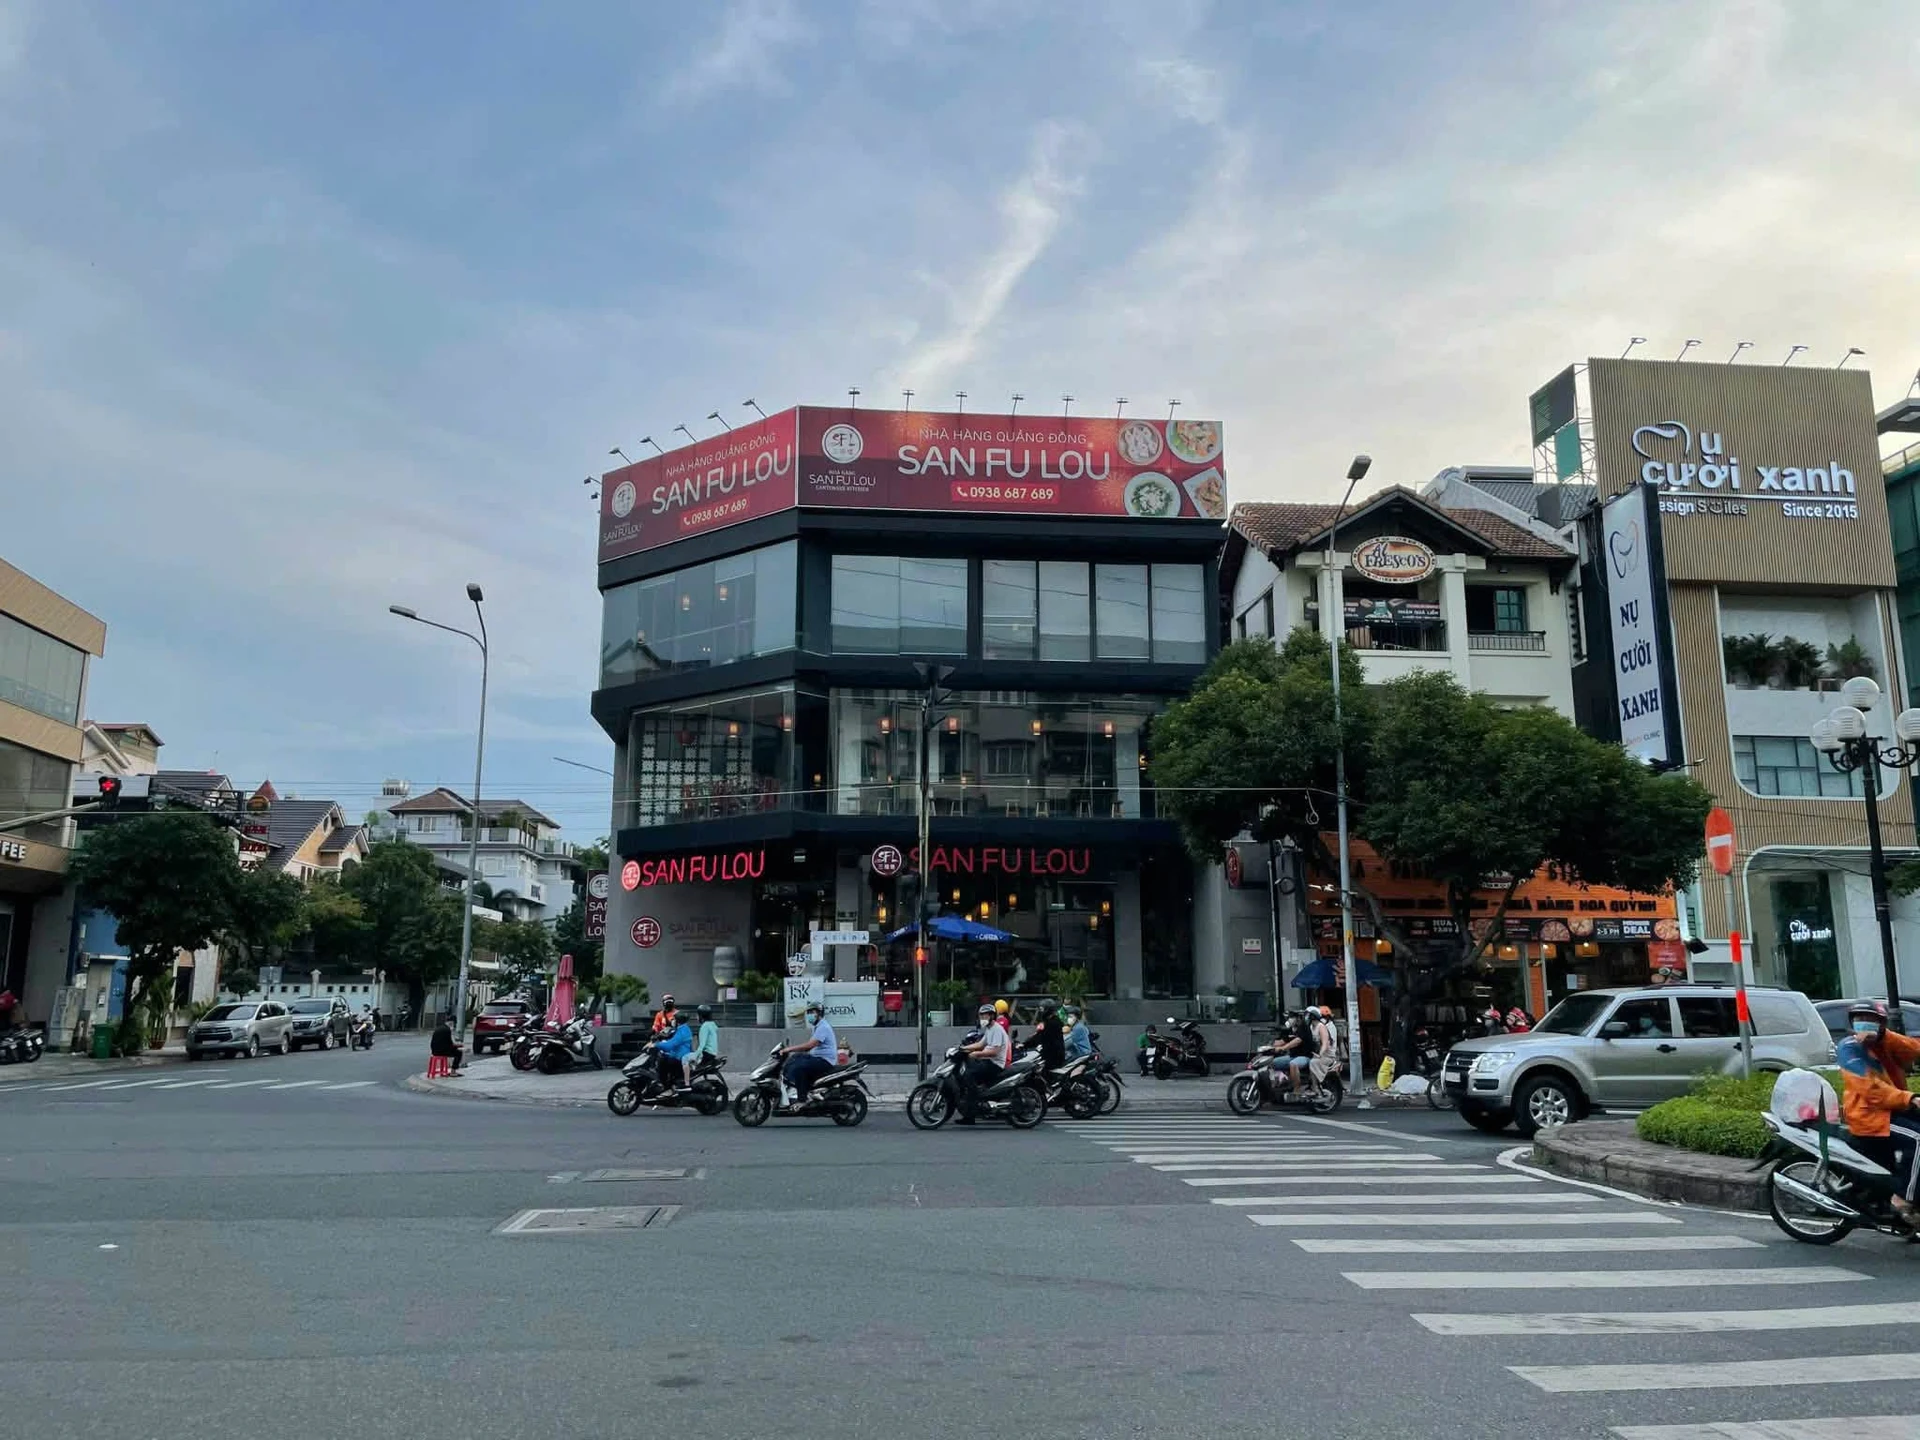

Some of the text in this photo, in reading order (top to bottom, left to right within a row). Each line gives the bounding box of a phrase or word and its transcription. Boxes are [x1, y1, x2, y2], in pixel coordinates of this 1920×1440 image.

[922, 428, 949, 440] NHÀ
[953, 429, 992, 441] HÀNG
[996, 429, 1044, 443] QUẢNG
[687, 454, 713, 471] HÀNG
[715, 442, 748, 463] QUẢNG
[897, 445, 1110, 480] SAN FU LOU
[652, 444, 791, 514] SAN FU LOU
[809, 474, 877, 487] SAN FU LOU
[1756, 458, 1855, 493] xanh
[970, 486, 1054, 500] 0938 687 689
[691, 499, 747, 524] 0938 687 689
[1659, 500, 1695, 517] esign
[1783, 502, 1858, 519] Since 2015
[1620, 599, 1639, 628] NỤ
[1621, 688, 1660, 722] XANH
[0, 840, 27, 859] FEE
[909, 848, 1090, 875] SAN FU LOU
[641, 857, 685, 886] SAN
[690, 854, 717, 883] FU
[721, 850, 765, 880] LOU
[1623, 925, 1651, 934] DEAL
